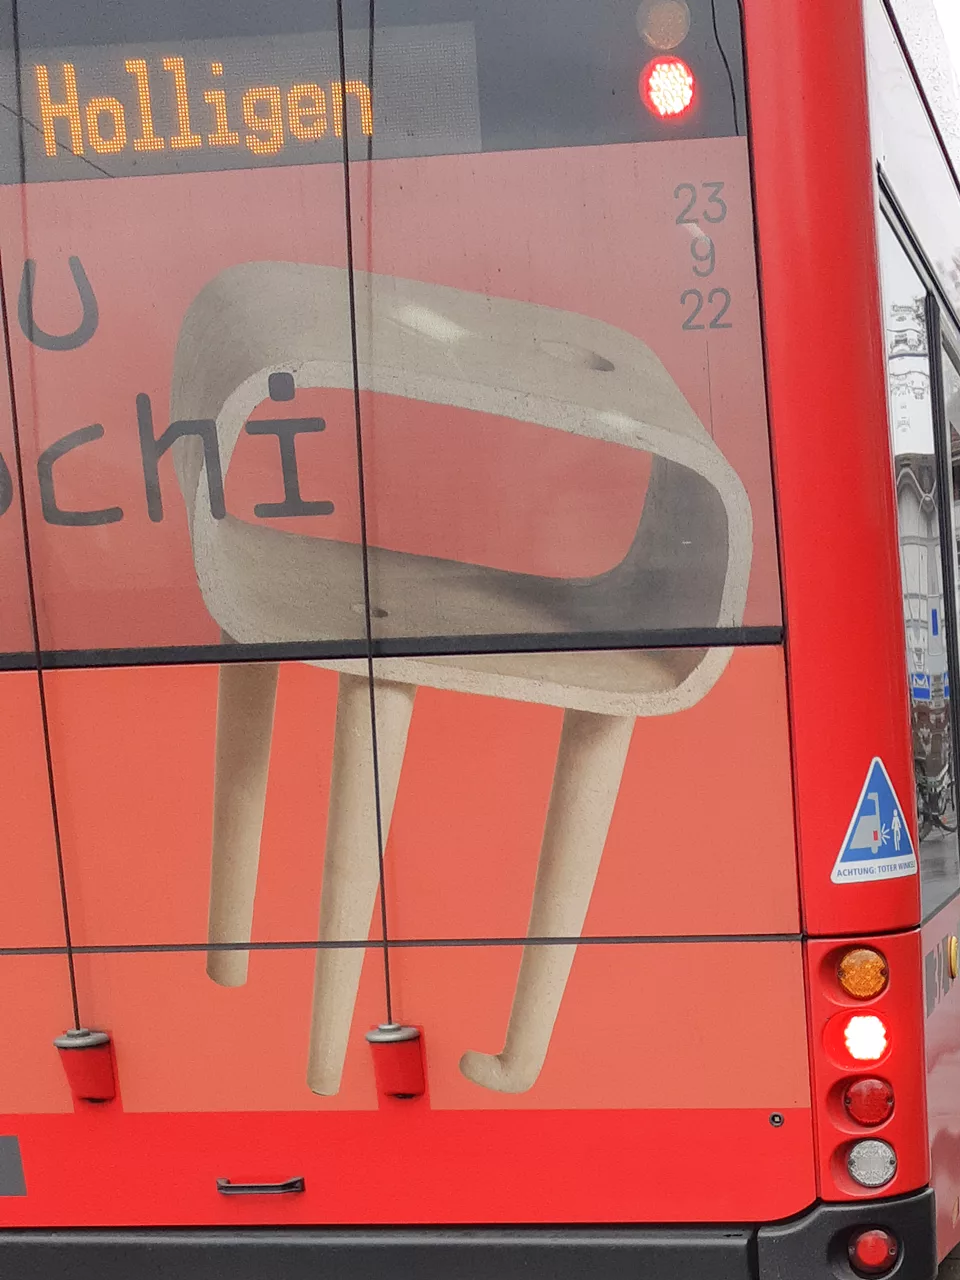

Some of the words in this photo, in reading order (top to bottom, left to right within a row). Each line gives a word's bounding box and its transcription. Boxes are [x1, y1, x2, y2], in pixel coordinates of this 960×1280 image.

[34, 56, 373, 157] Holligen
[673, 181, 728, 225] 23
[690, 233, 716, 278] 9
[680, 287, 733, 331] 22
[837, 866, 877, 877] ACHTUNG:
[878, 863, 898, 874] TOTER
